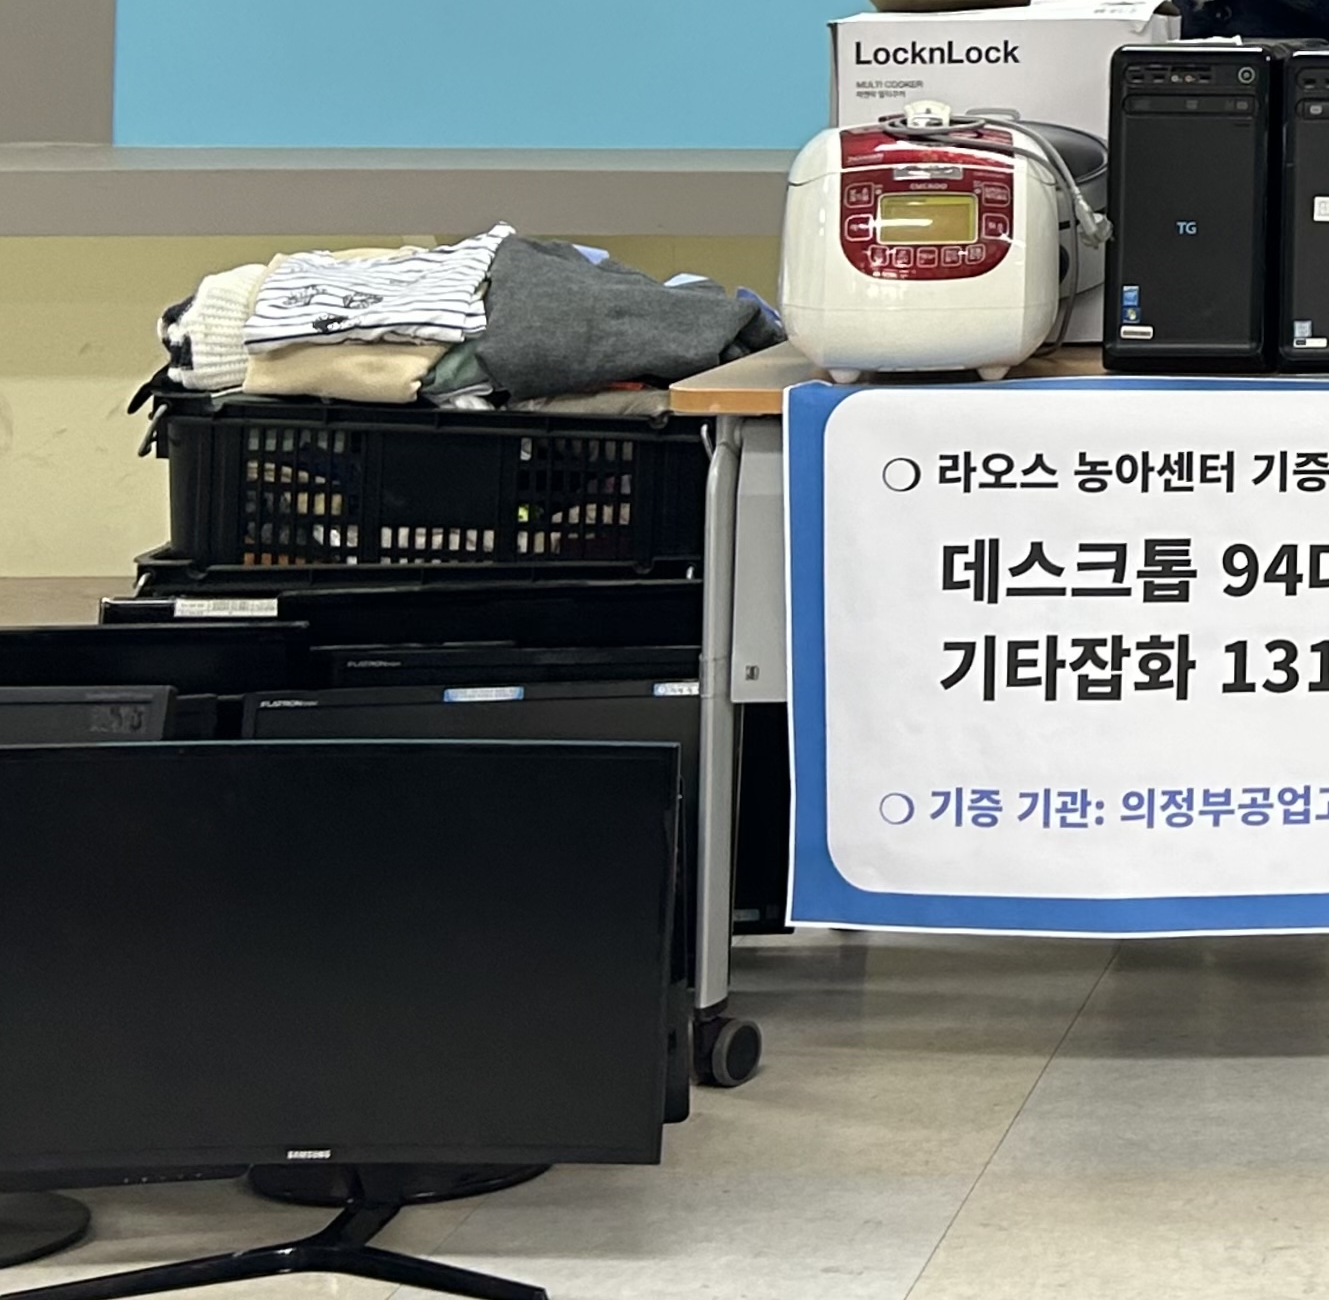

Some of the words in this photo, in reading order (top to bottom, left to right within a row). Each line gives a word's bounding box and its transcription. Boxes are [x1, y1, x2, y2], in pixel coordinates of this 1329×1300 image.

[855, 39, 1020, 66] LocknLock
[1176, 221, 1197, 235] TG
[938, 450, 1059, 494] 라오스
[1073, 450, 1235, 494] 농아센터
[941, 537, 1198, 605] 데스크톱
[939, 633, 1197, 702] 기타잡화
[929, 786, 1004, 829] 기증
[1017, 787, 1105, 829] 기관:
